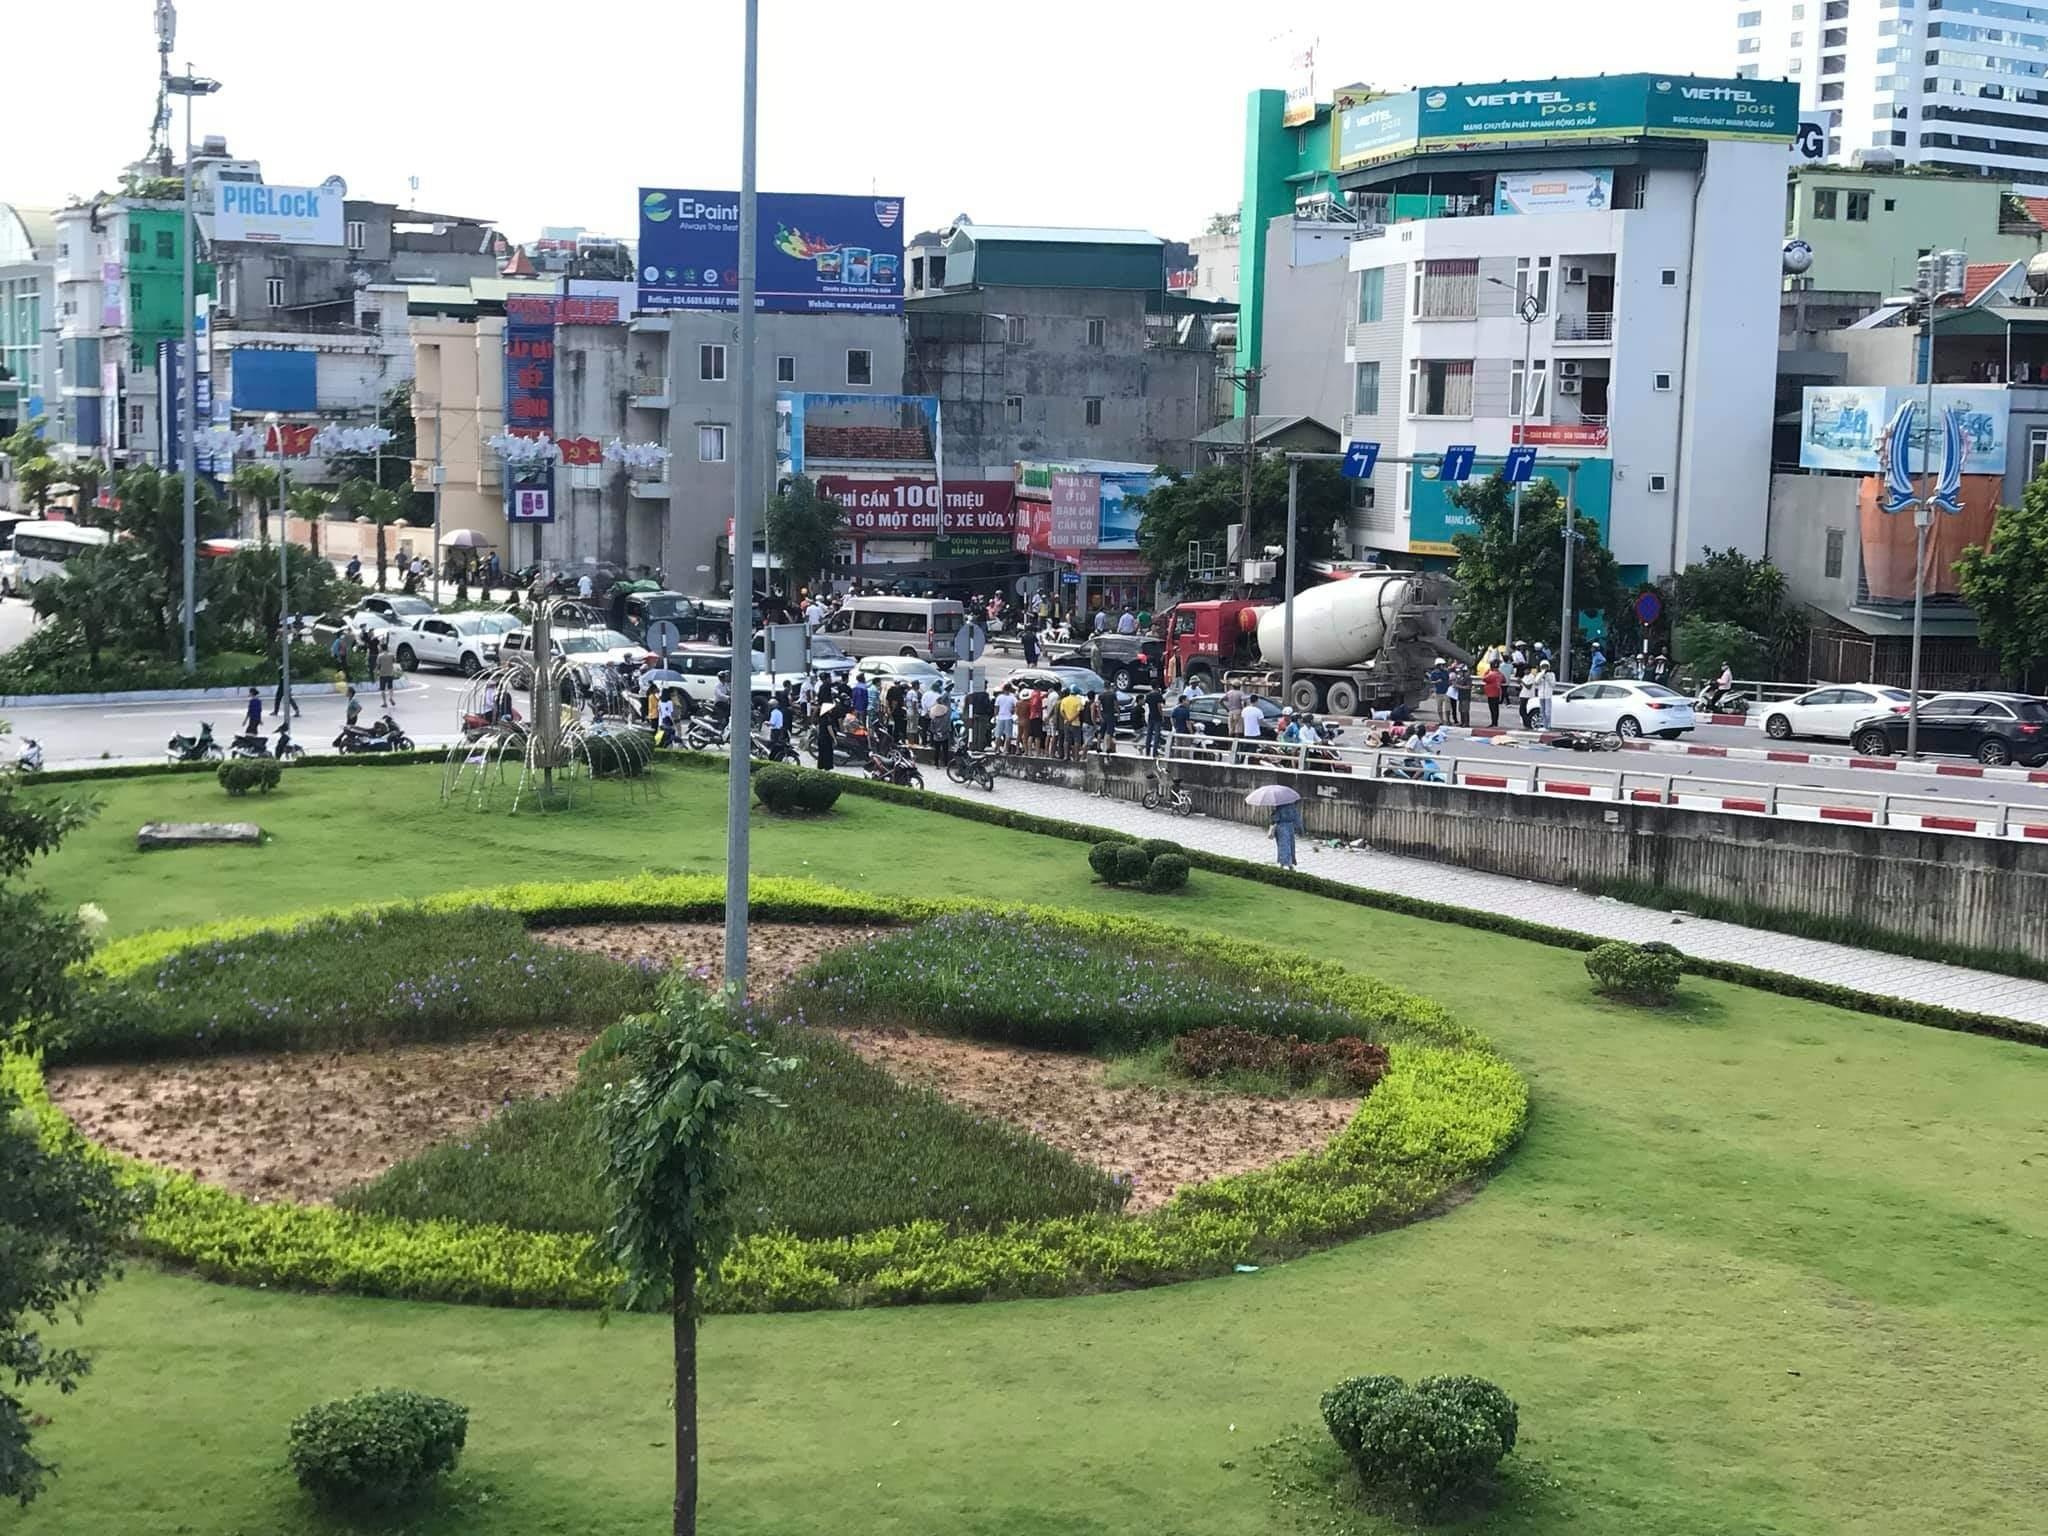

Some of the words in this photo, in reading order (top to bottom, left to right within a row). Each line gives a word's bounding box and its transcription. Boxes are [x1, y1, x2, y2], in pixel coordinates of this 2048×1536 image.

[1465, 91, 1570, 107] VIETTEL
[1681, 87, 1757, 102] VIETTEL
[1541, 101, 1597, 116] post
[1736, 103, 1776, 115] post
[945, 490, 984, 510] TRIỆU
[856, 511, 874, 527] CÓ
[878, 510, 909, 530] MỘT
[912, 513, 953, 527] CHIC
[956, 513, 974, 527] XE
[977, 510, 1004, 527] VỪA
